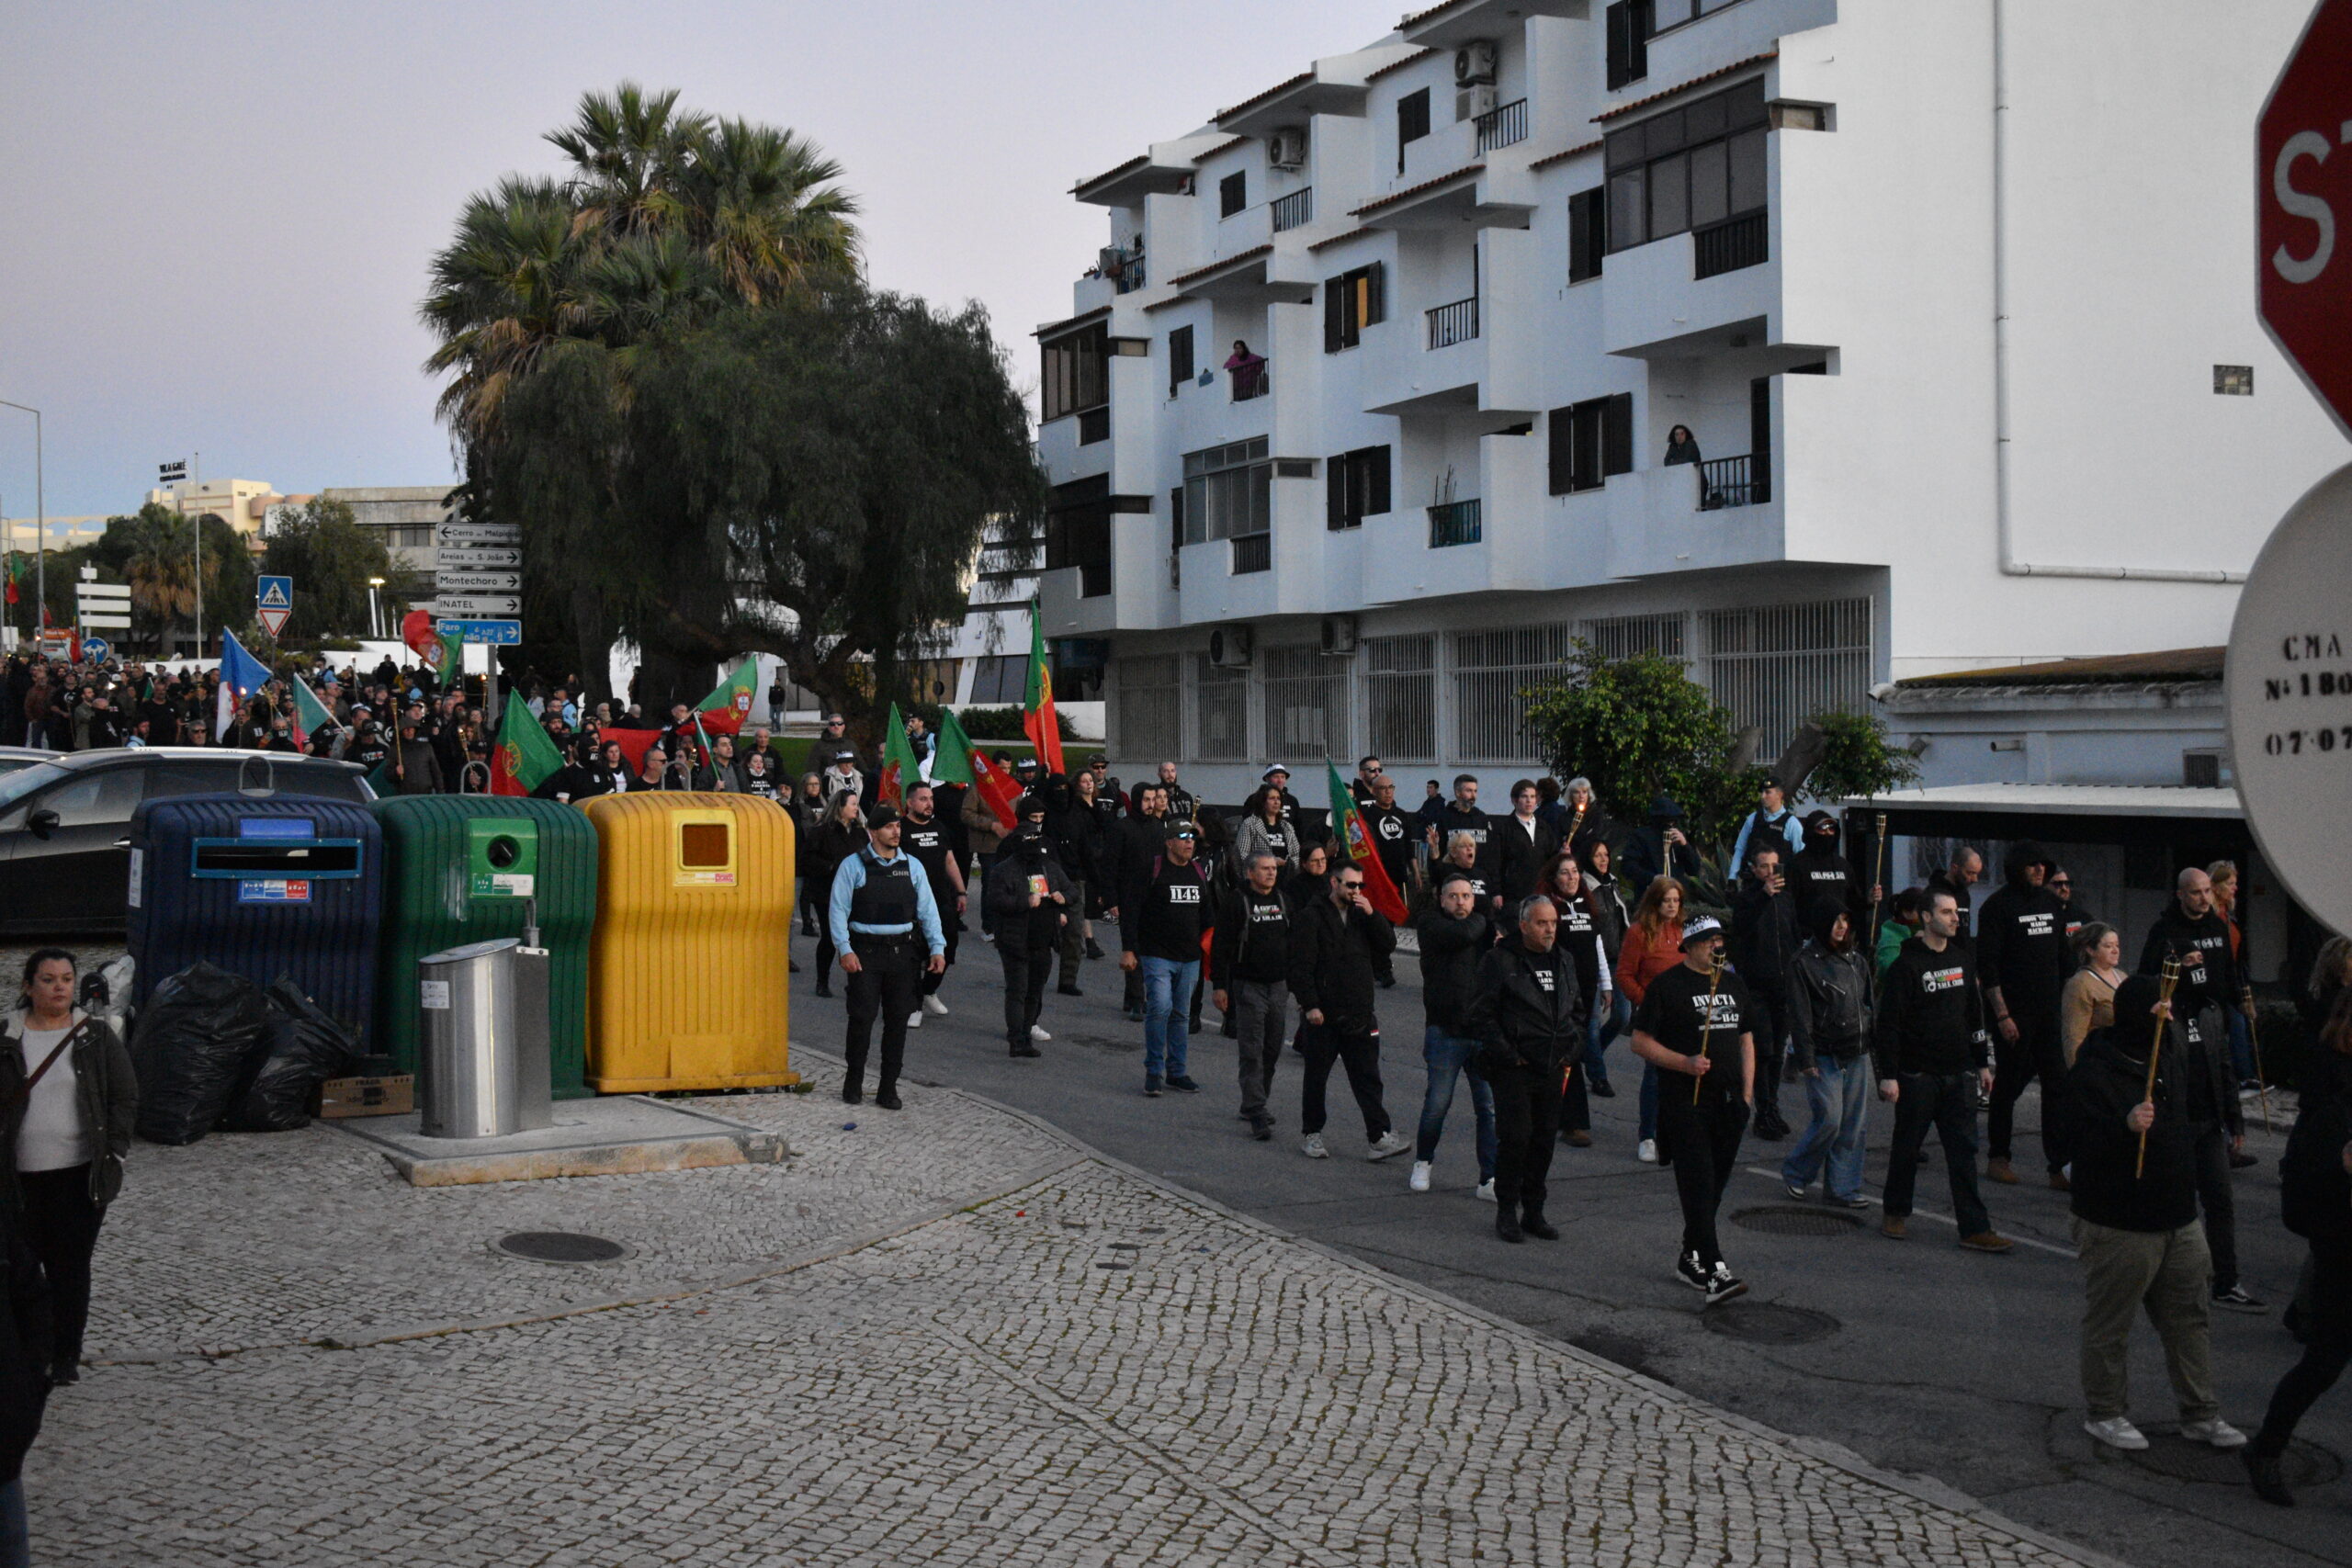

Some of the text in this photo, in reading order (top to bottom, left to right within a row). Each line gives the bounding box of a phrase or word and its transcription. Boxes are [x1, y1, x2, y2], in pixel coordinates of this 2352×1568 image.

[440, 552, 465, 560] Areias
[440, 575, 498, 585] Montechoro
[440, 600, 474, 609] INATEL
[440, 622, 460, 632] Faro
[2283, 634, 2341, 661] CMA
[1170, 887, 1200, 901] 1143
[1691, 993, 1736, 1008] INVICTA
[1722, 1012, 1739, 1022] 1143
